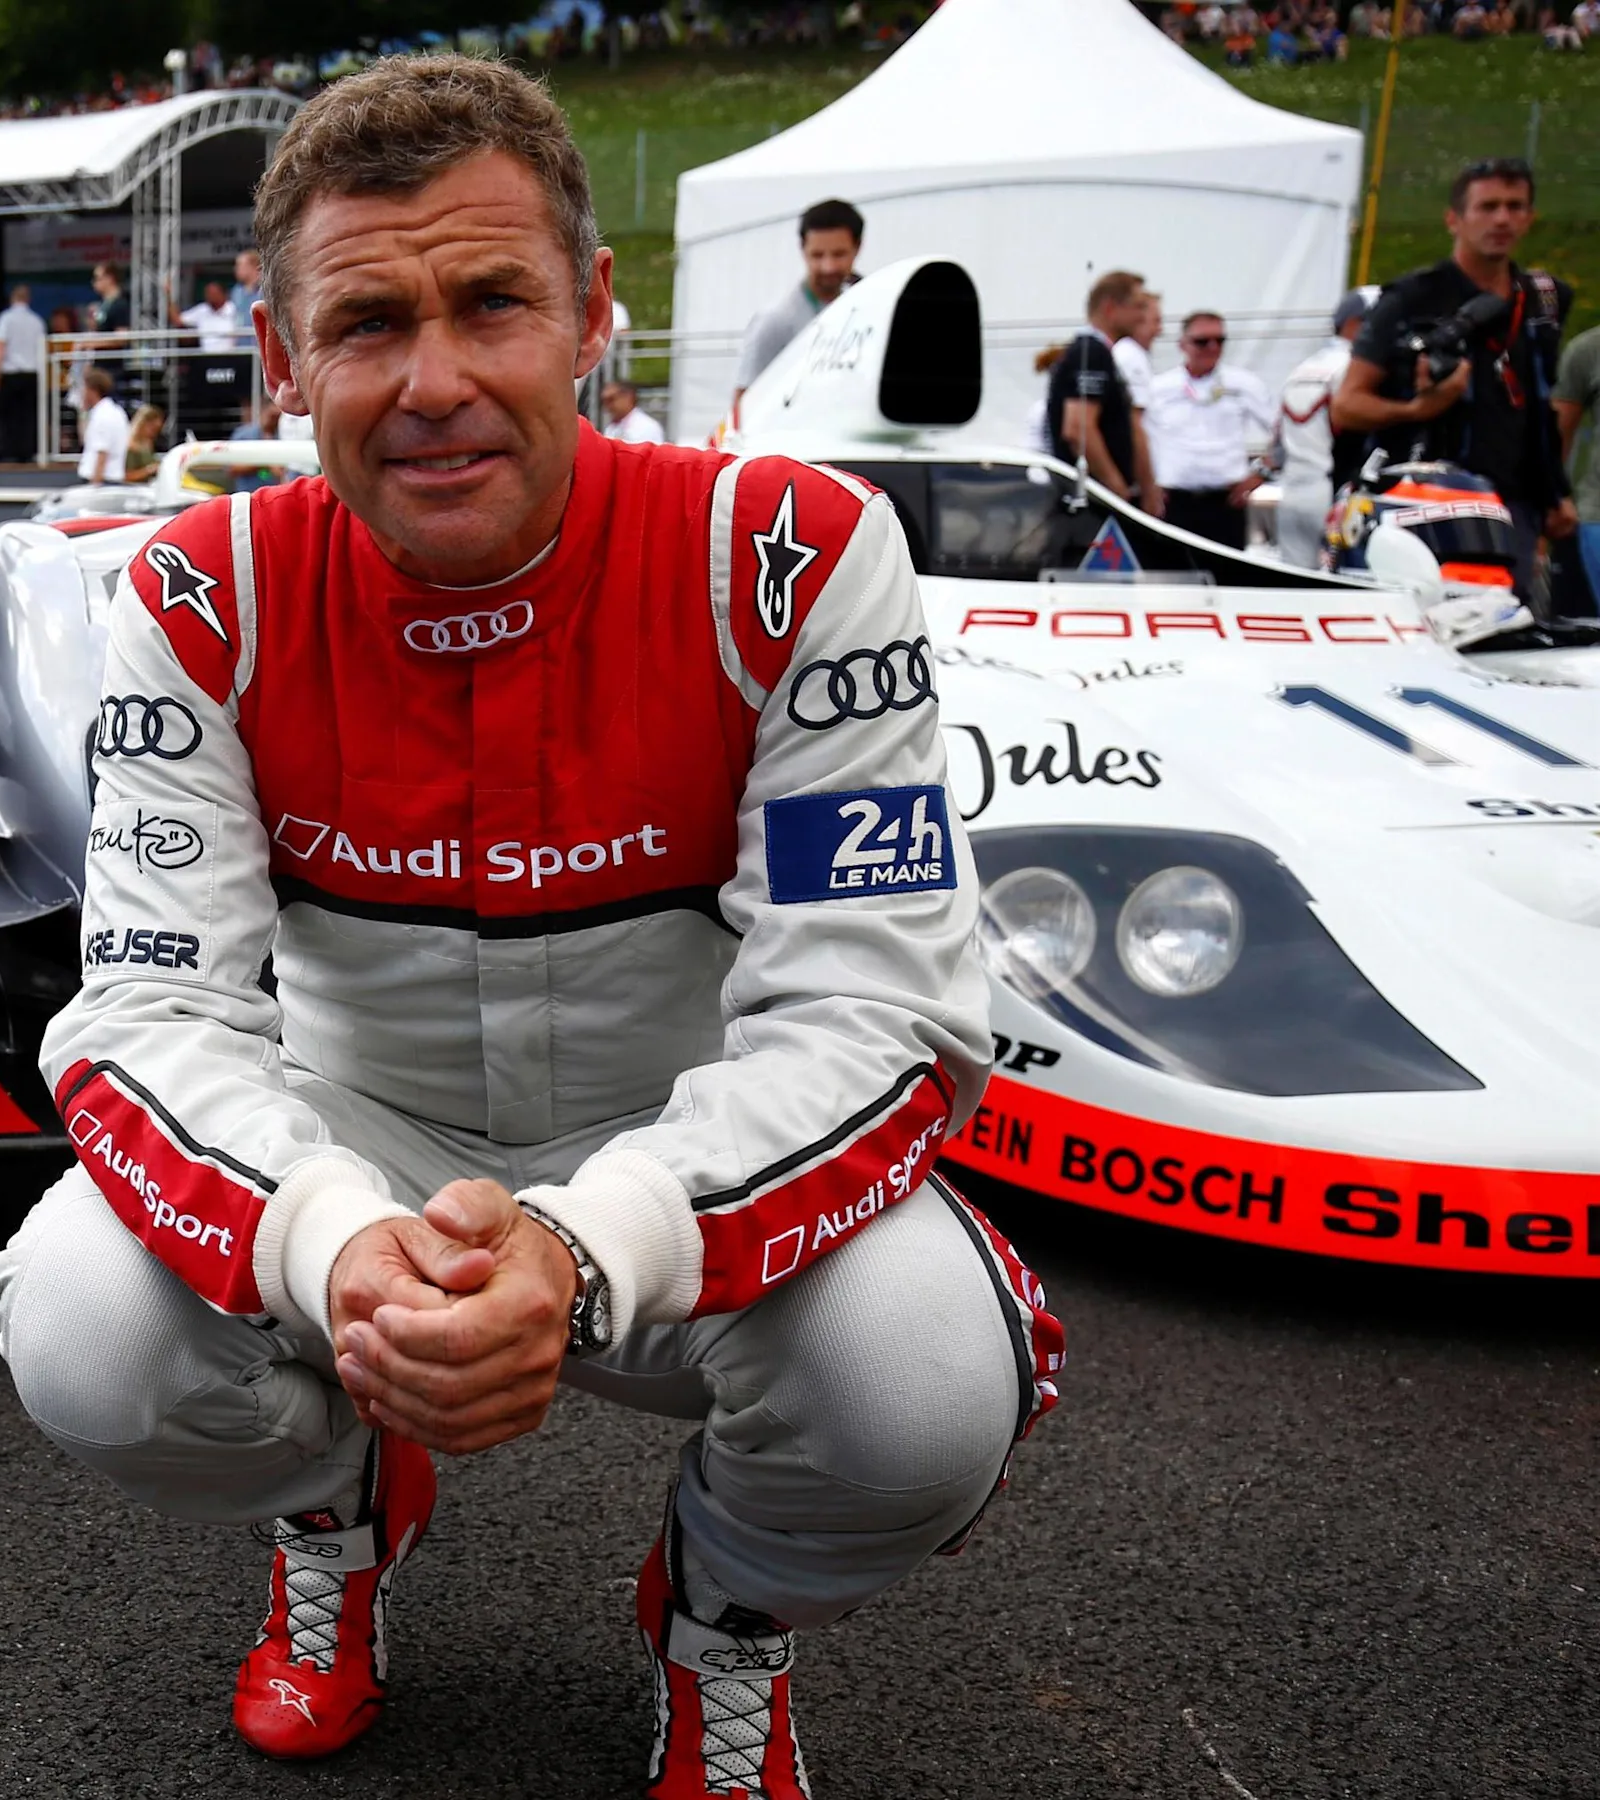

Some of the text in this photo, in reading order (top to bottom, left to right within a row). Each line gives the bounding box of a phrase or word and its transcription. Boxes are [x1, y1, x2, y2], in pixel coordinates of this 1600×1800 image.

[1052, 658, 1186, 690] Jules
[1268, 683, 1596, 769] 11
[939, 717, 1163, 822] Jules
[1466, 798, 1600, 818] Sh
[331, 824, 667, 889] Audi Sport
[831, 795, 943, 868] 24h
[829, 861, 943, 889] LE MANS
[92, 1132, 235, 1257] Audi Sport
[811, 1116, 946, 1251] Audi Sport
[1060, 1133, 1286, 1224] BOSCH
